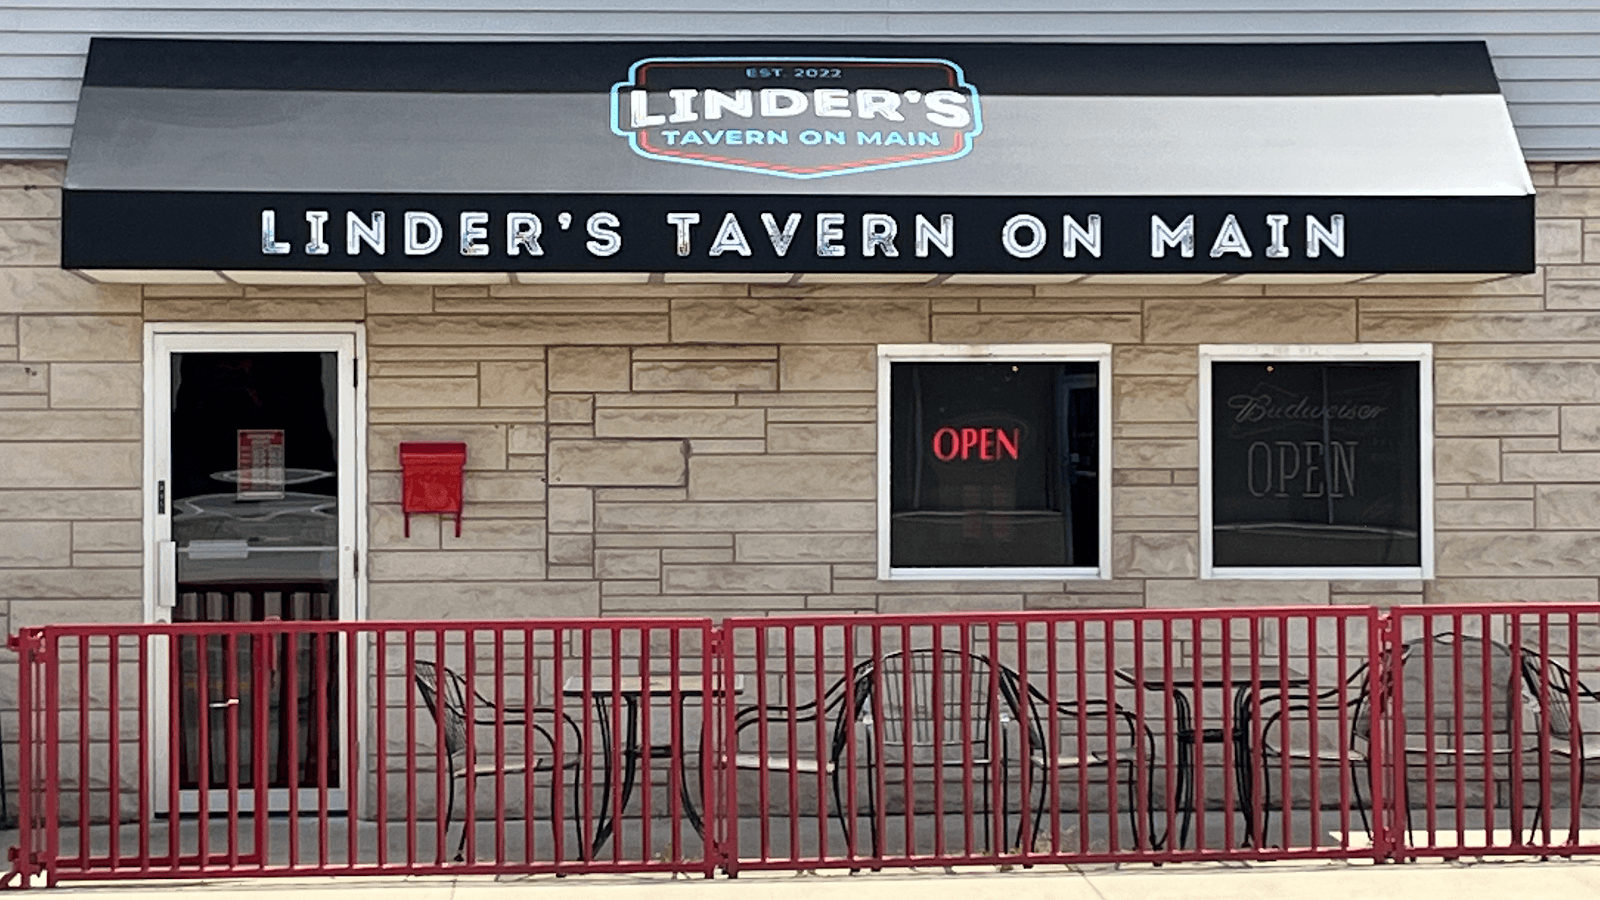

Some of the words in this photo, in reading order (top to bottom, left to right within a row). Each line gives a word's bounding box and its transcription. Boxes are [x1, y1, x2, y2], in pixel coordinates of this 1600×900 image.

[794, 67, 842, 78] 2022
[630, 88, 971, 128] LINDER'S
[661, 129, 789, 146] TAVERN
[799, 130, 846, 146] ON
[857, 130, 940, 147] MAIN
[261, 209, 622, 257] LINDER'S
[666, 212, 954, 258] TAVERN
[1001, 213, 1102, 259] ON
[1150, 213, 1345, 259] MAIN
[1227, 394, 1388, 423] Budweiser
[932, 426, 1020, 463] OPEN
[1247, 440, 1359, 498] OPEN
